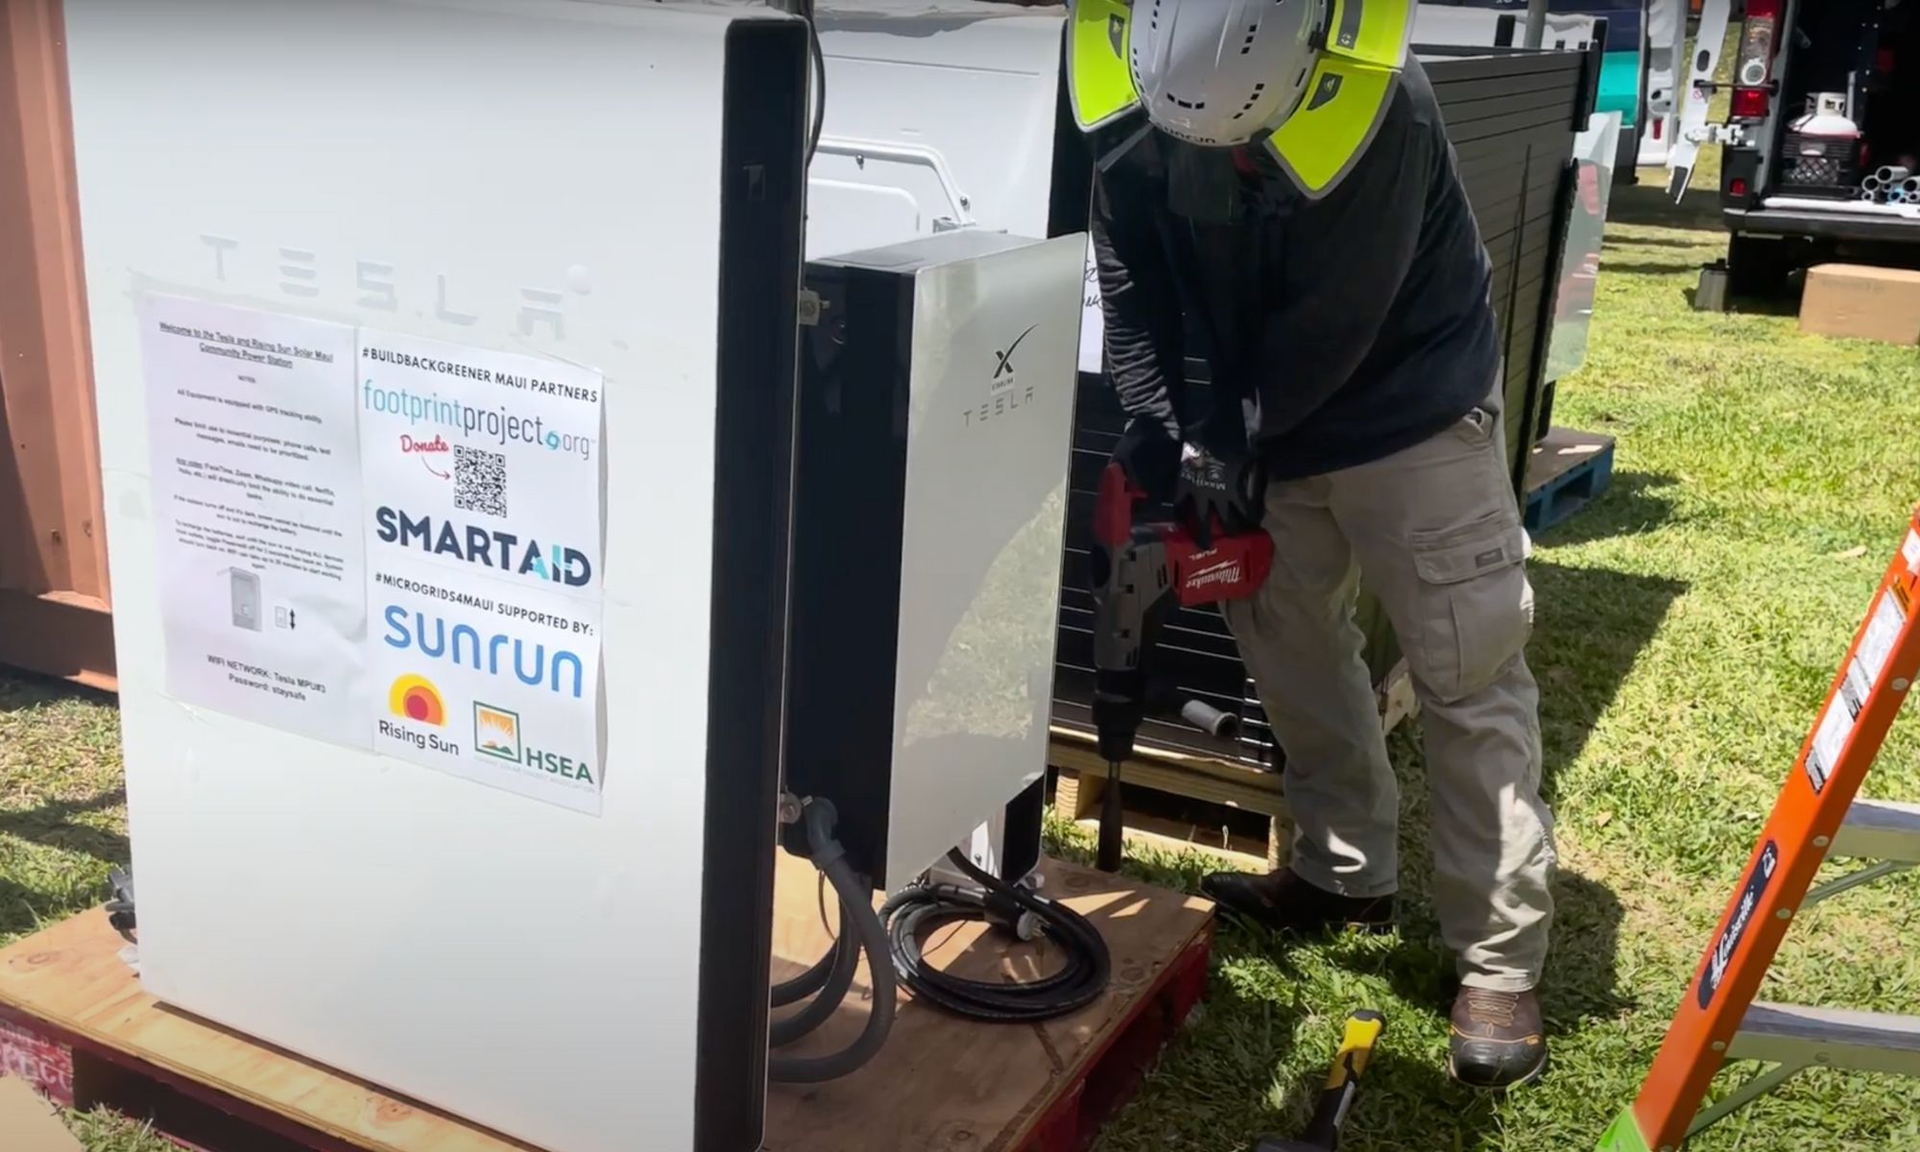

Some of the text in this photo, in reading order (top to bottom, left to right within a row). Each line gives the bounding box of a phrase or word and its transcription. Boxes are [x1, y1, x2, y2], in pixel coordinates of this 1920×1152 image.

[200, 234, 564, 340] TESLA
[160, 323, 191, 336] Welcome
[203, 331, 214, 341] the
[215, 333, 234, 345] Tesla
[237, 337, 249, 347] and
[252, 340, 274, 352] Rising
[277, 344, 291, 356] Sun
[294, 348, 313, 360] Solar
[315, 352, 333, 364] Maui
[200, 343, 292, 369] Community Power Station
[363, 347, 598, 403] #BUILDBACKGREENER MAUI PARTNERS
[963, 386, 1034, 428] TESLA
[400, 433, 449, 453] Donate
[376, 506, 592, 587] SMARTAID
[375, 573, 594, 637] #MICROGRIDS4MAUI SUPPORTED BY:
[384, 605, 583, 699] sunrun
[274, 672, 295, 685] Tesla
[379, 719, 459, 756] Rising Sun
[526, 747, 595, 785] HSEA
